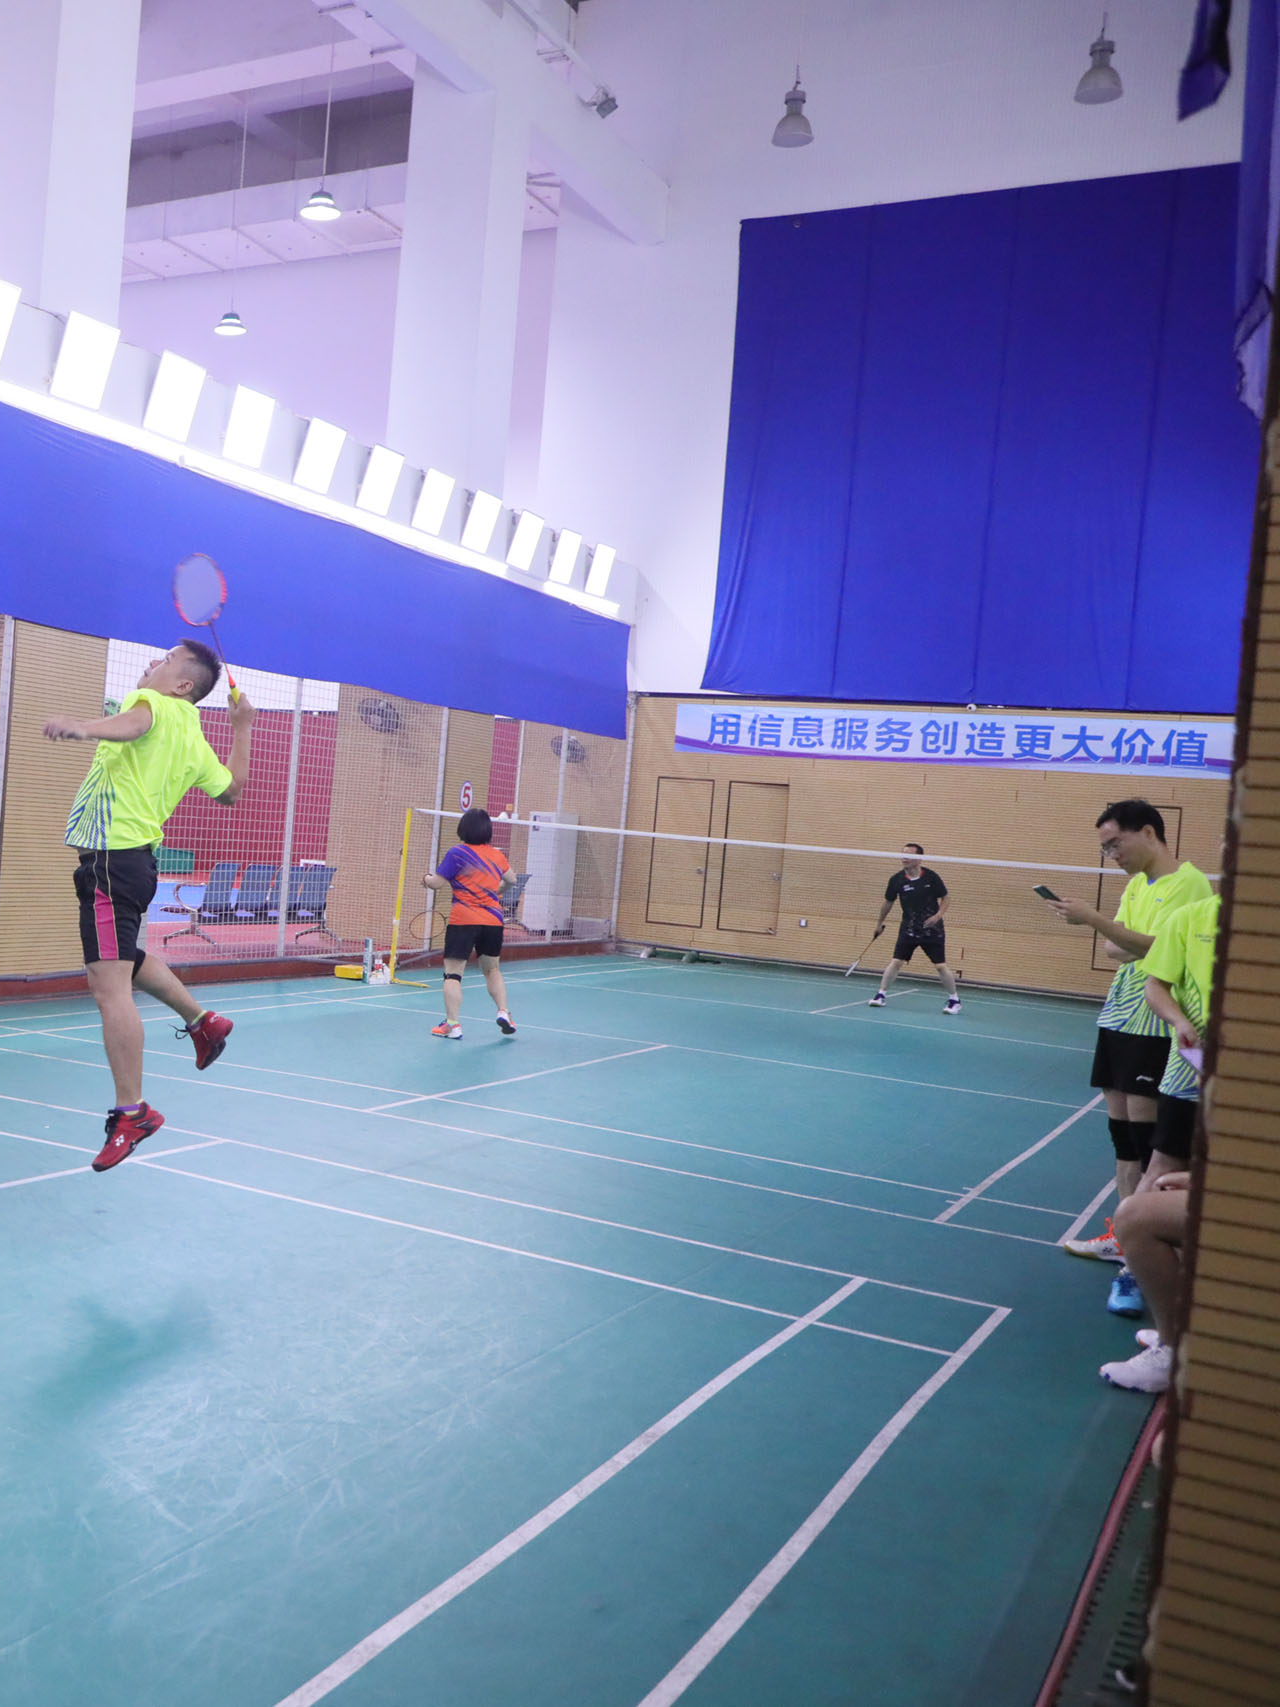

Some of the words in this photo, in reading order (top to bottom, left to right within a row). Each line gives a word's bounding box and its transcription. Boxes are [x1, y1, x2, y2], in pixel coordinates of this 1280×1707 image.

[708, 713, 1208, 767] 用信息服务创造更大价值
[462, 786, 471, 808] 5
